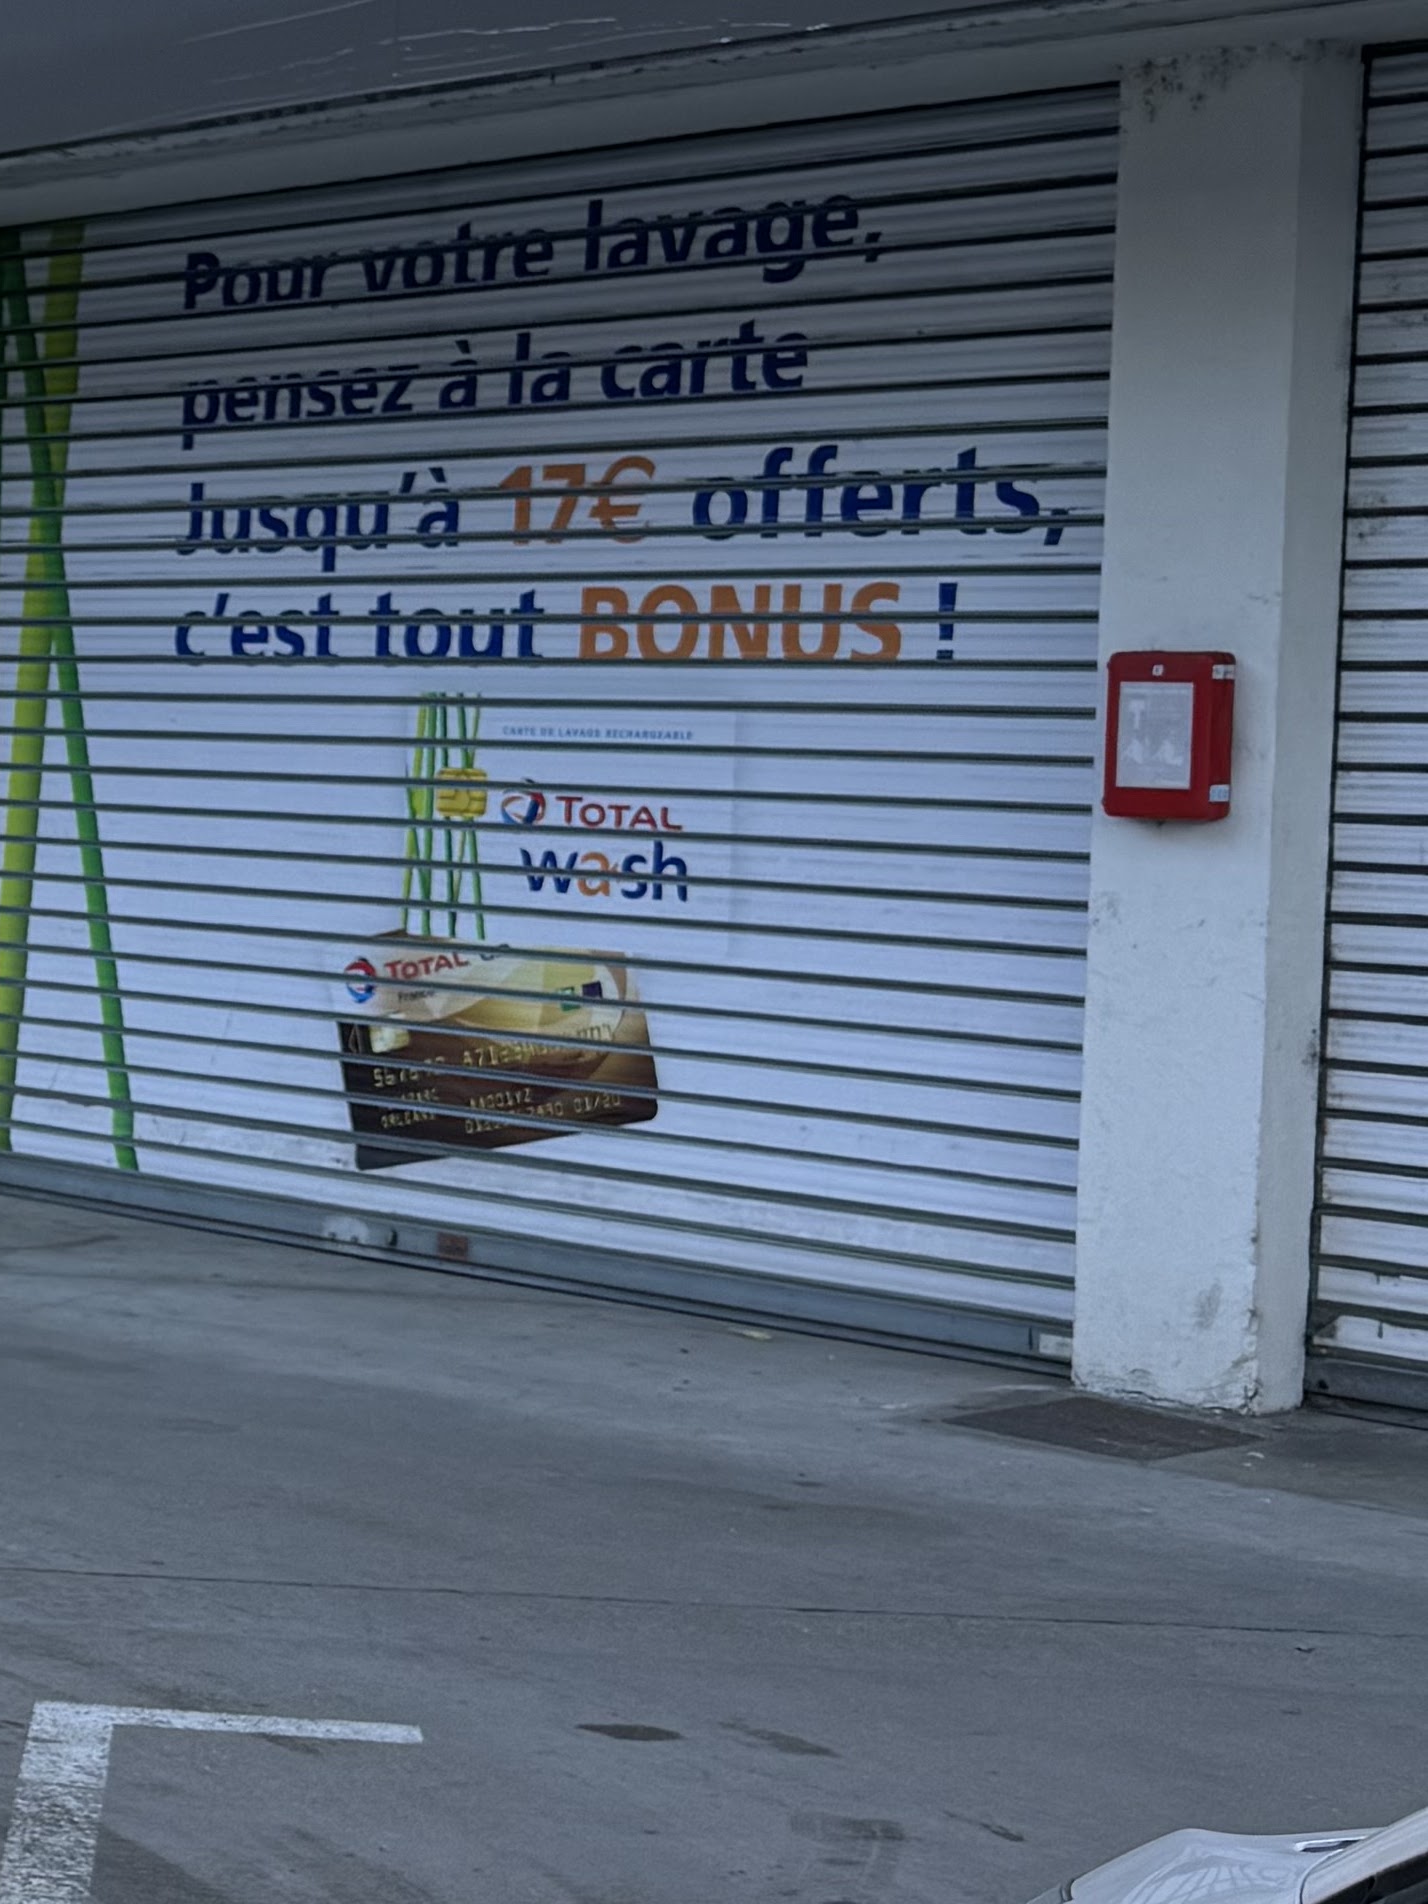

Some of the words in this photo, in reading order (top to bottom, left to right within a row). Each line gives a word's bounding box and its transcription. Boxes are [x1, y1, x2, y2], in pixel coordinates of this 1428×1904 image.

[182, 249, 338, 310] Pour
[362, 219, 555, 293] votre
[583, 195, 886, 284] lavage,
[180, 362, 420, 450] pensez
[438, 339, 481, 410] à
[507, 332, 572, 406] la
[598, 318, 810, 400] carte
[175, 465, 461, 572] Jusqu'à
[496, 454, 657, 546] 17€
[692, 444, 1072, 546] offerts,
[174, 592, 342, 664] c'est
[369, 589, 544, 664] tout
[578, 581, 903, 663] BONUS
[936, 580, 959, 661] !
[502, 725, 537, 737] CARTE
[540, 726, 555, 737] DE
[557, 727, 602, 739] LAVAGE
[605, 728, 694, 741] RECHARGEABLE
[520, 839, 689, 903] wash
[383, 952, 470, 979] TOTAL
